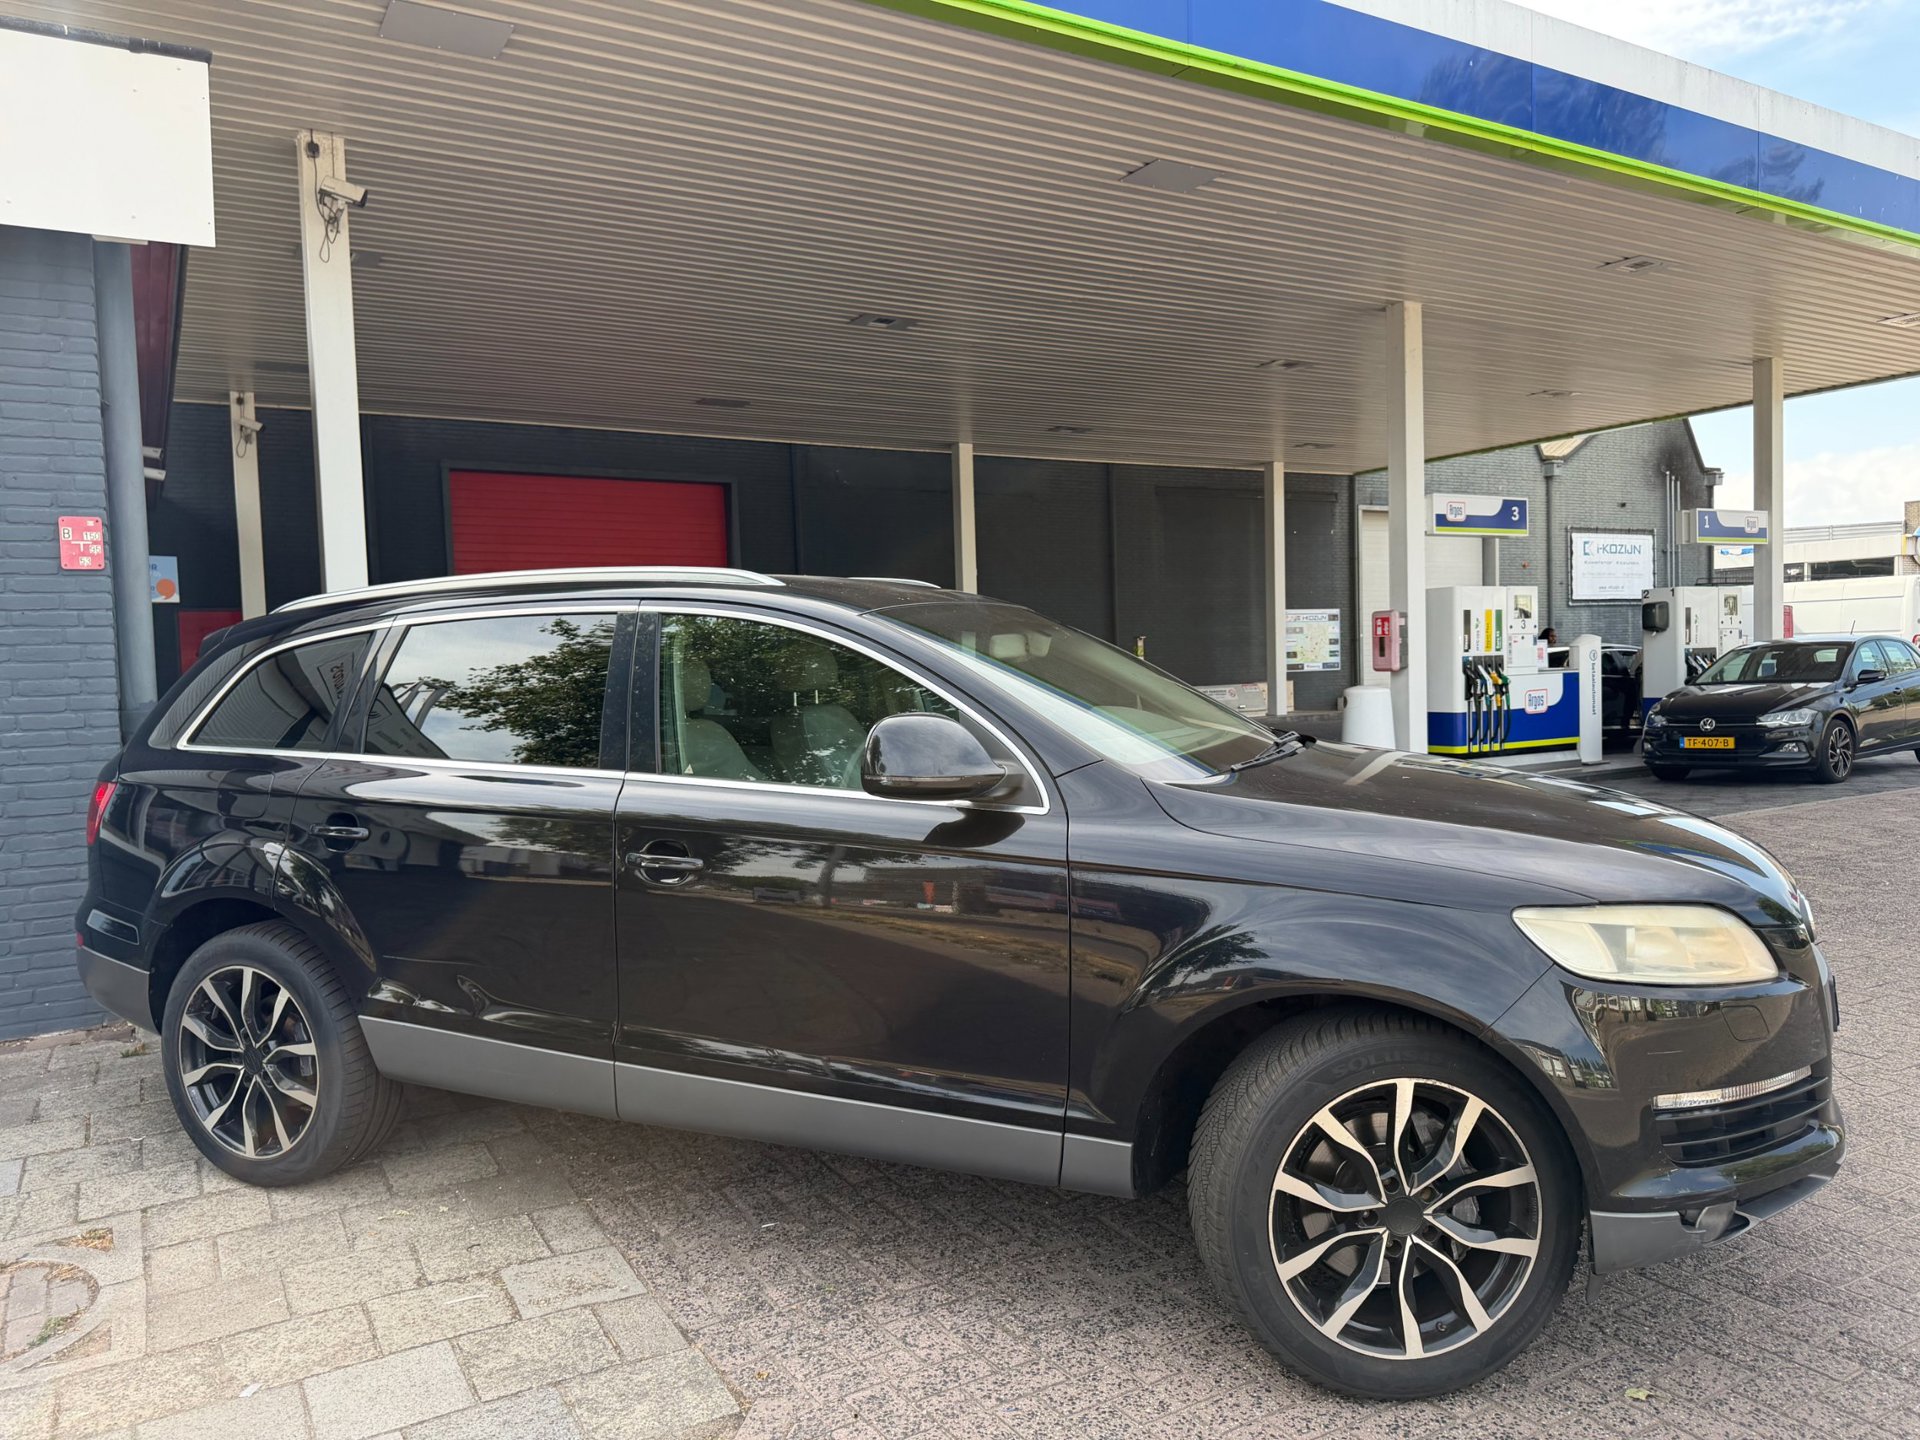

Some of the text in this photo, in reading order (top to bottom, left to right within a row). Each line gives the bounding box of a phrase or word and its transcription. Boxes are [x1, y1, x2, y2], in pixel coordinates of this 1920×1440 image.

[1511, 506, 1520, 521] 3
[1704, 515, 1710, 529] 1
[62, 528, 71, 539] B
[1643, 589, 1650, 599] 2
[1670, 588, 1675, 597] 1
[1520, 619, 1526, 630] 3
[1528, 693, 1544, 710] Argos
[1687, 738, 1729, 747] TF-407-B
